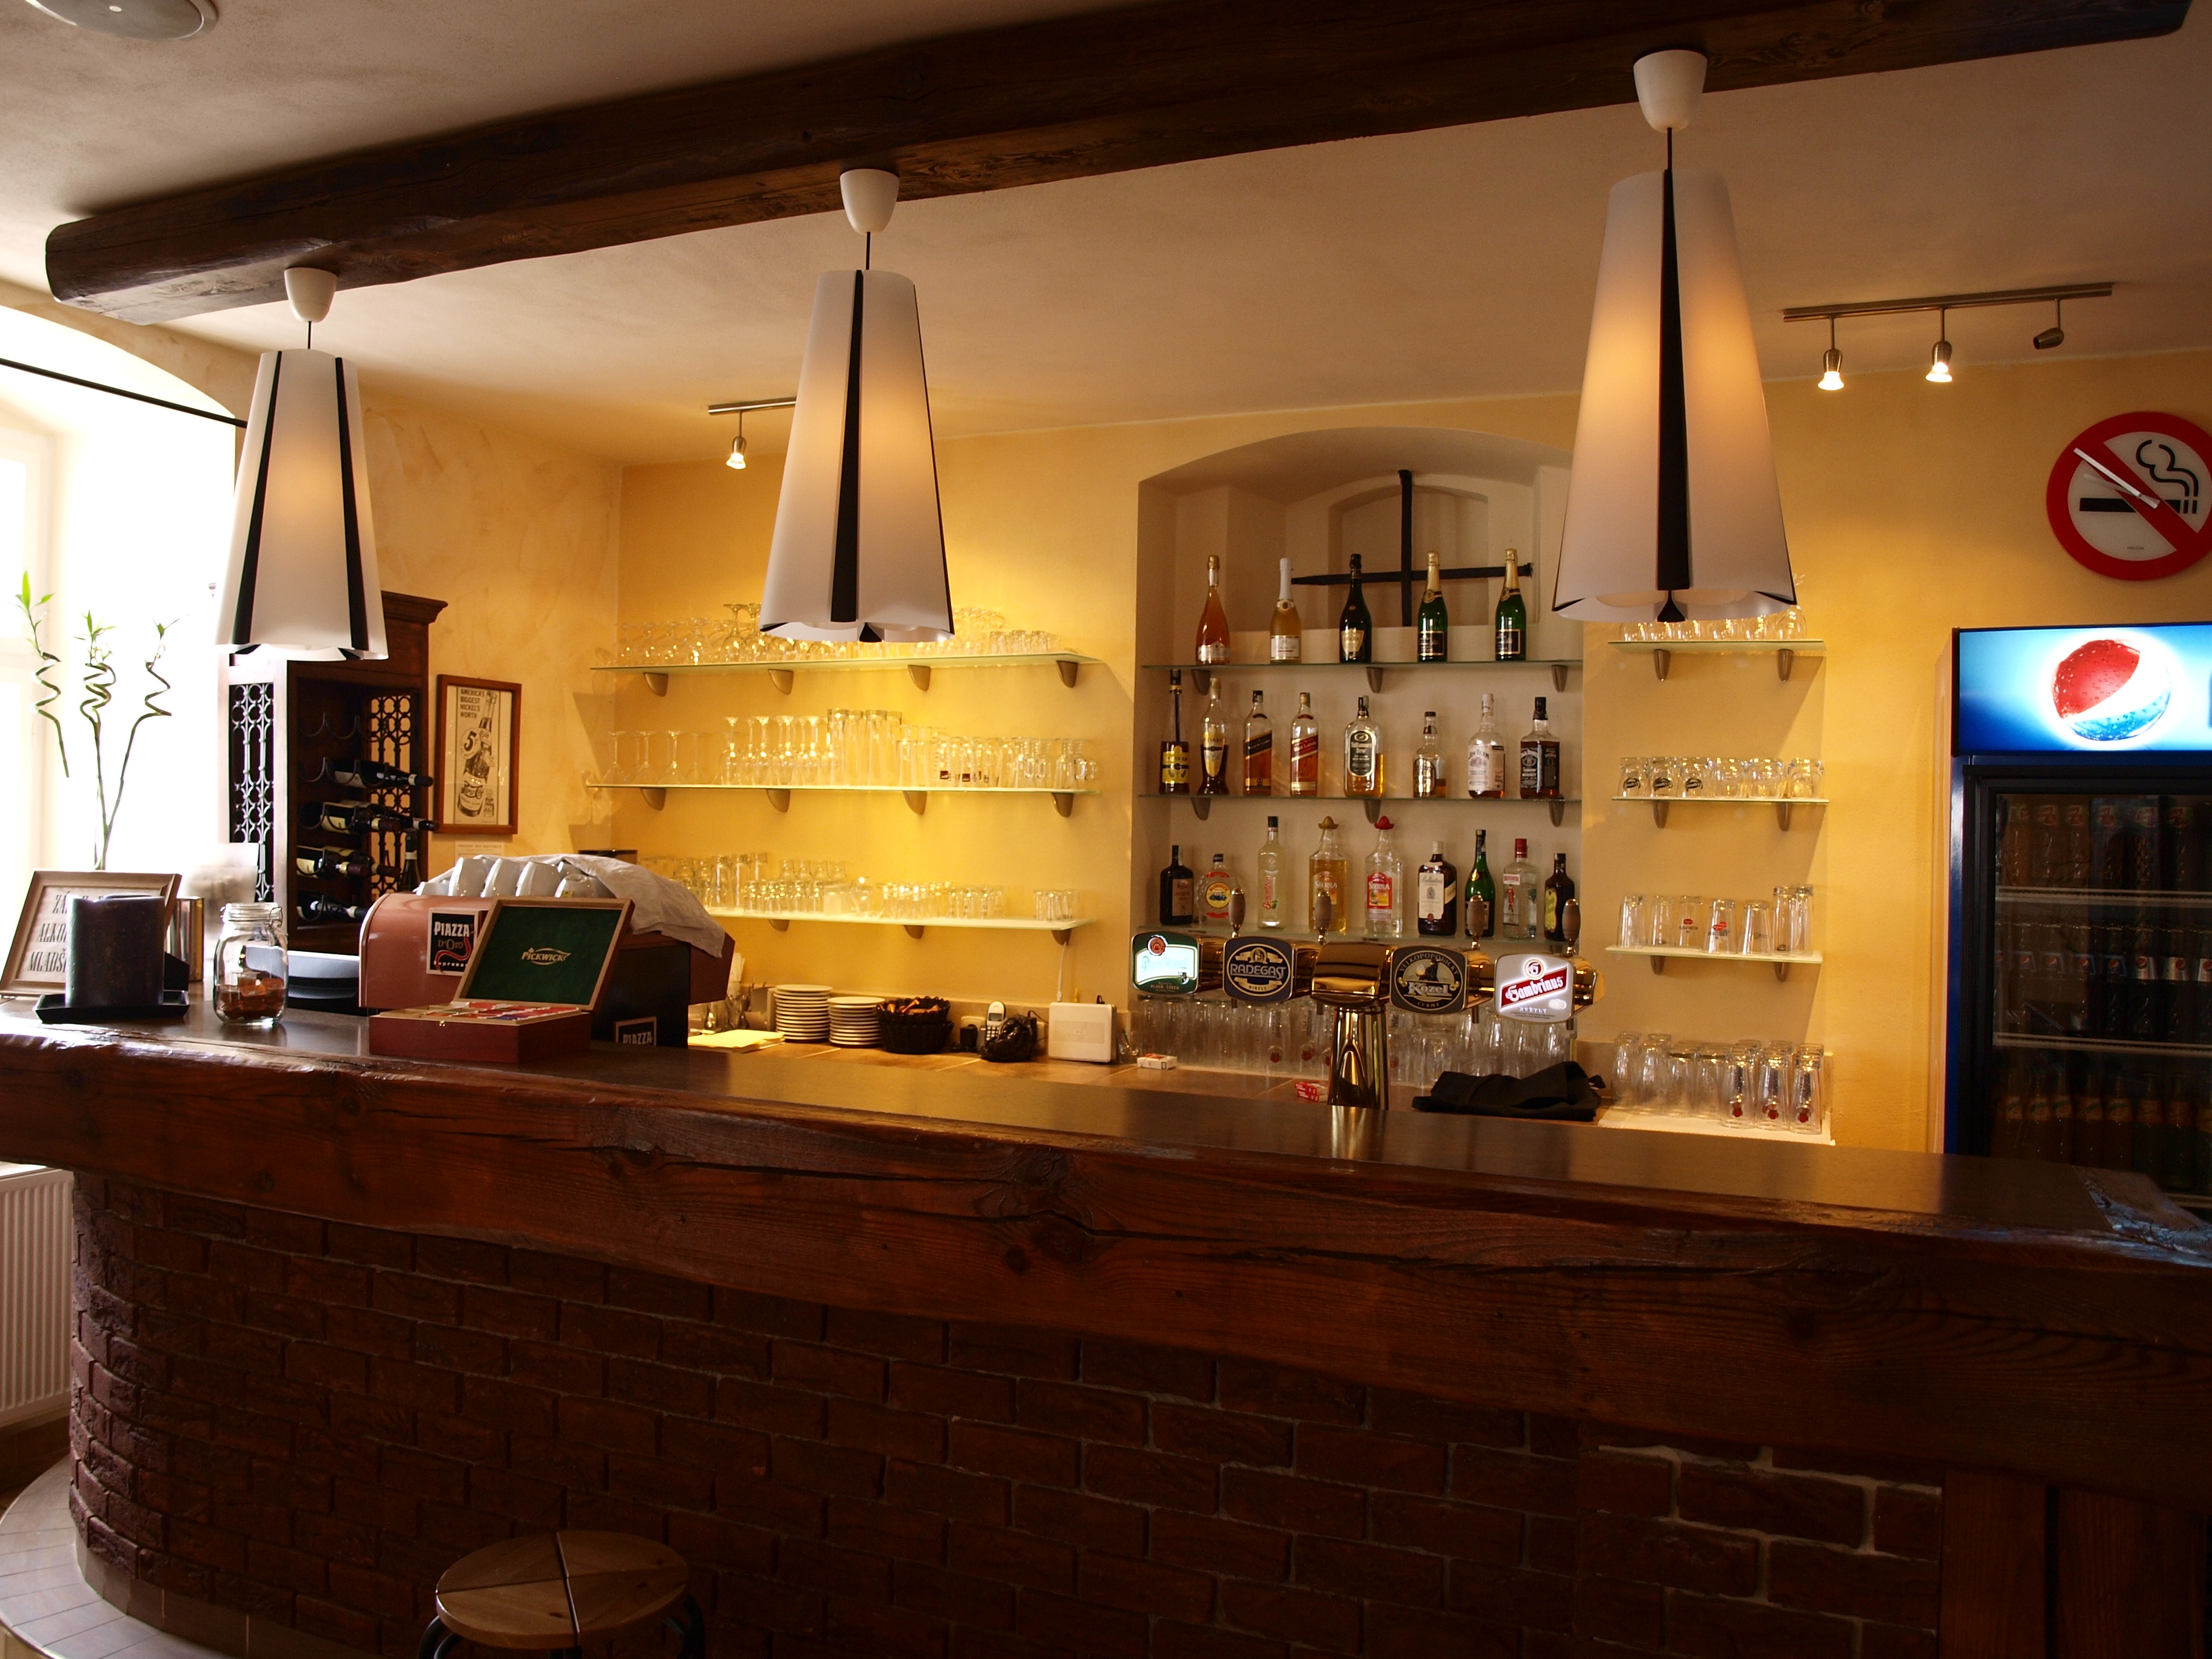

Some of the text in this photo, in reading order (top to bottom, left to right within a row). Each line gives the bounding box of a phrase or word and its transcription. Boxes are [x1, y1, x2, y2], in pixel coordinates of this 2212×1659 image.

[1315, 880, 1338, 889] SIERRA
[1369, 881, 1390, 890] SIERRA
[36, 923, 67, 942] ALKO
[434, 921, 470, 937] PIAZZA
[27, 948, 67, 973] MLADŠ
[1230, 964, 1287, 980] RADEGAST
[1408, 982, 1449, 997] Kozel
[1505, 976, 1564, 1002] Gambrinus
[623, 1031, 652, 1045] PIAZZA
